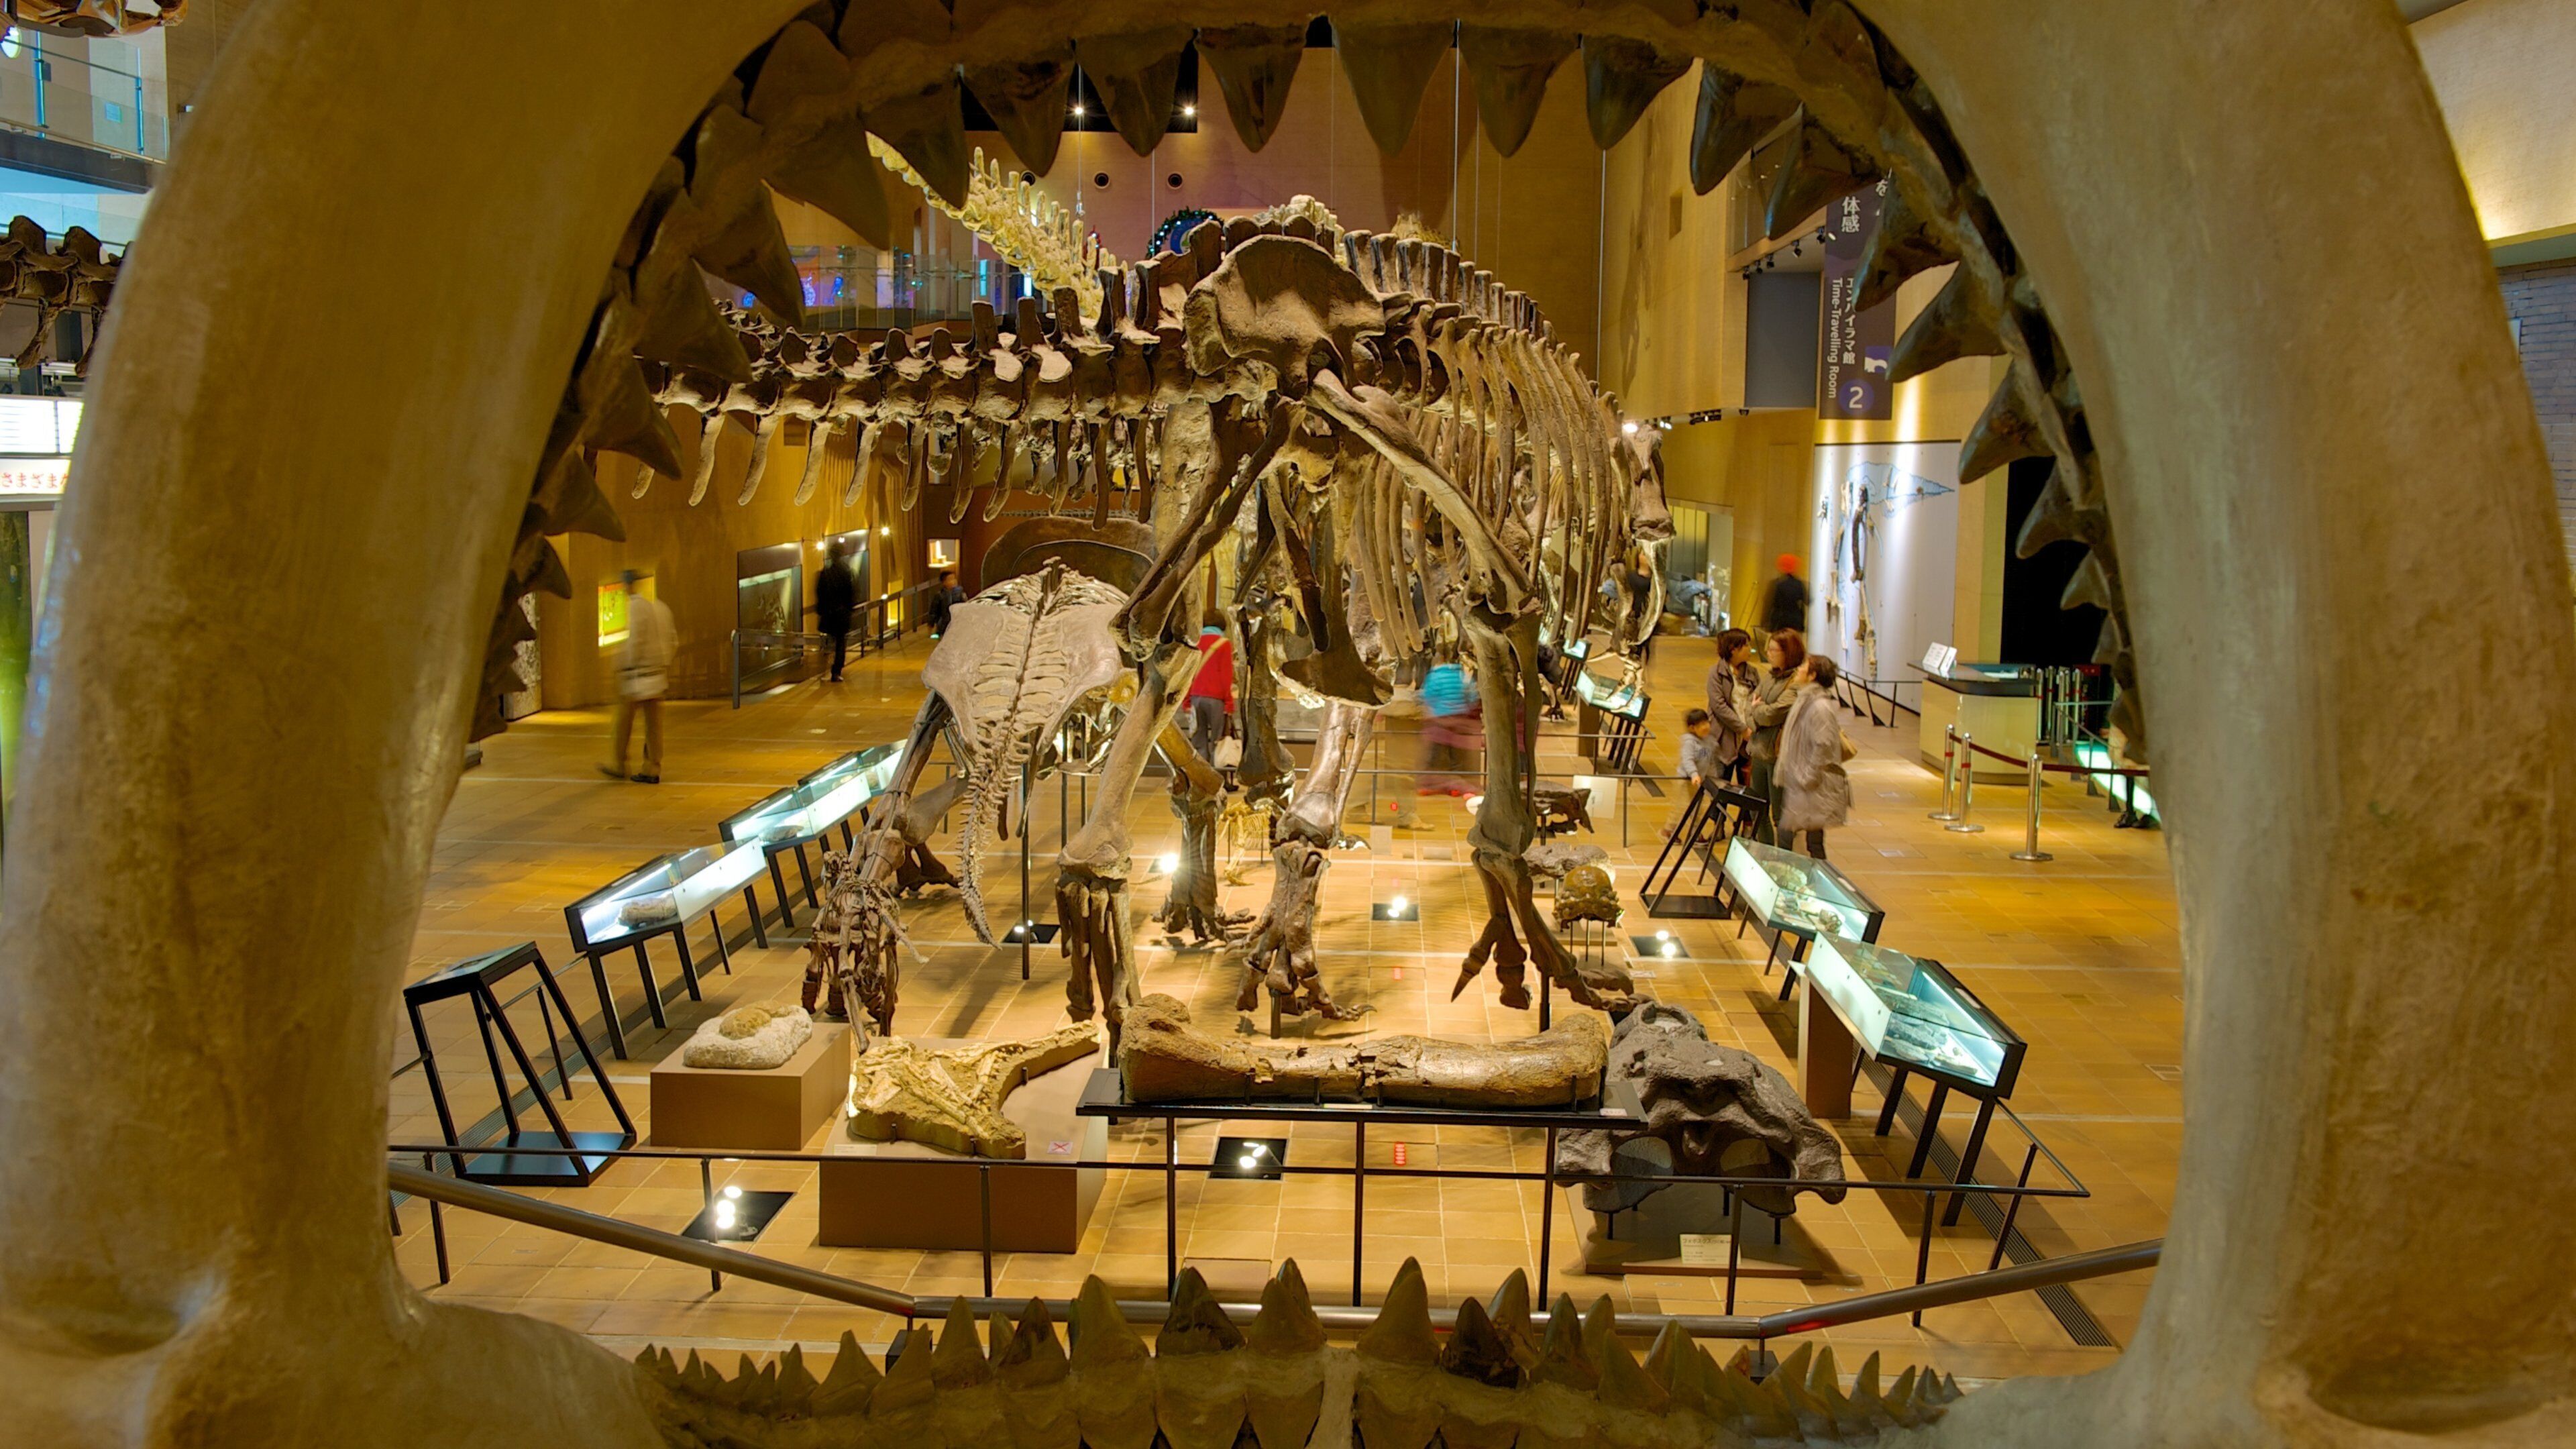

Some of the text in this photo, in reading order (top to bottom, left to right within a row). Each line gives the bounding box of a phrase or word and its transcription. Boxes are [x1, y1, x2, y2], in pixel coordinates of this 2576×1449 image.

[1841, 196, 1860, 233] 体感
[1827, 278, 1843, 398] Time-Travelling Room
[1849, 386, 1864, 409] 2
